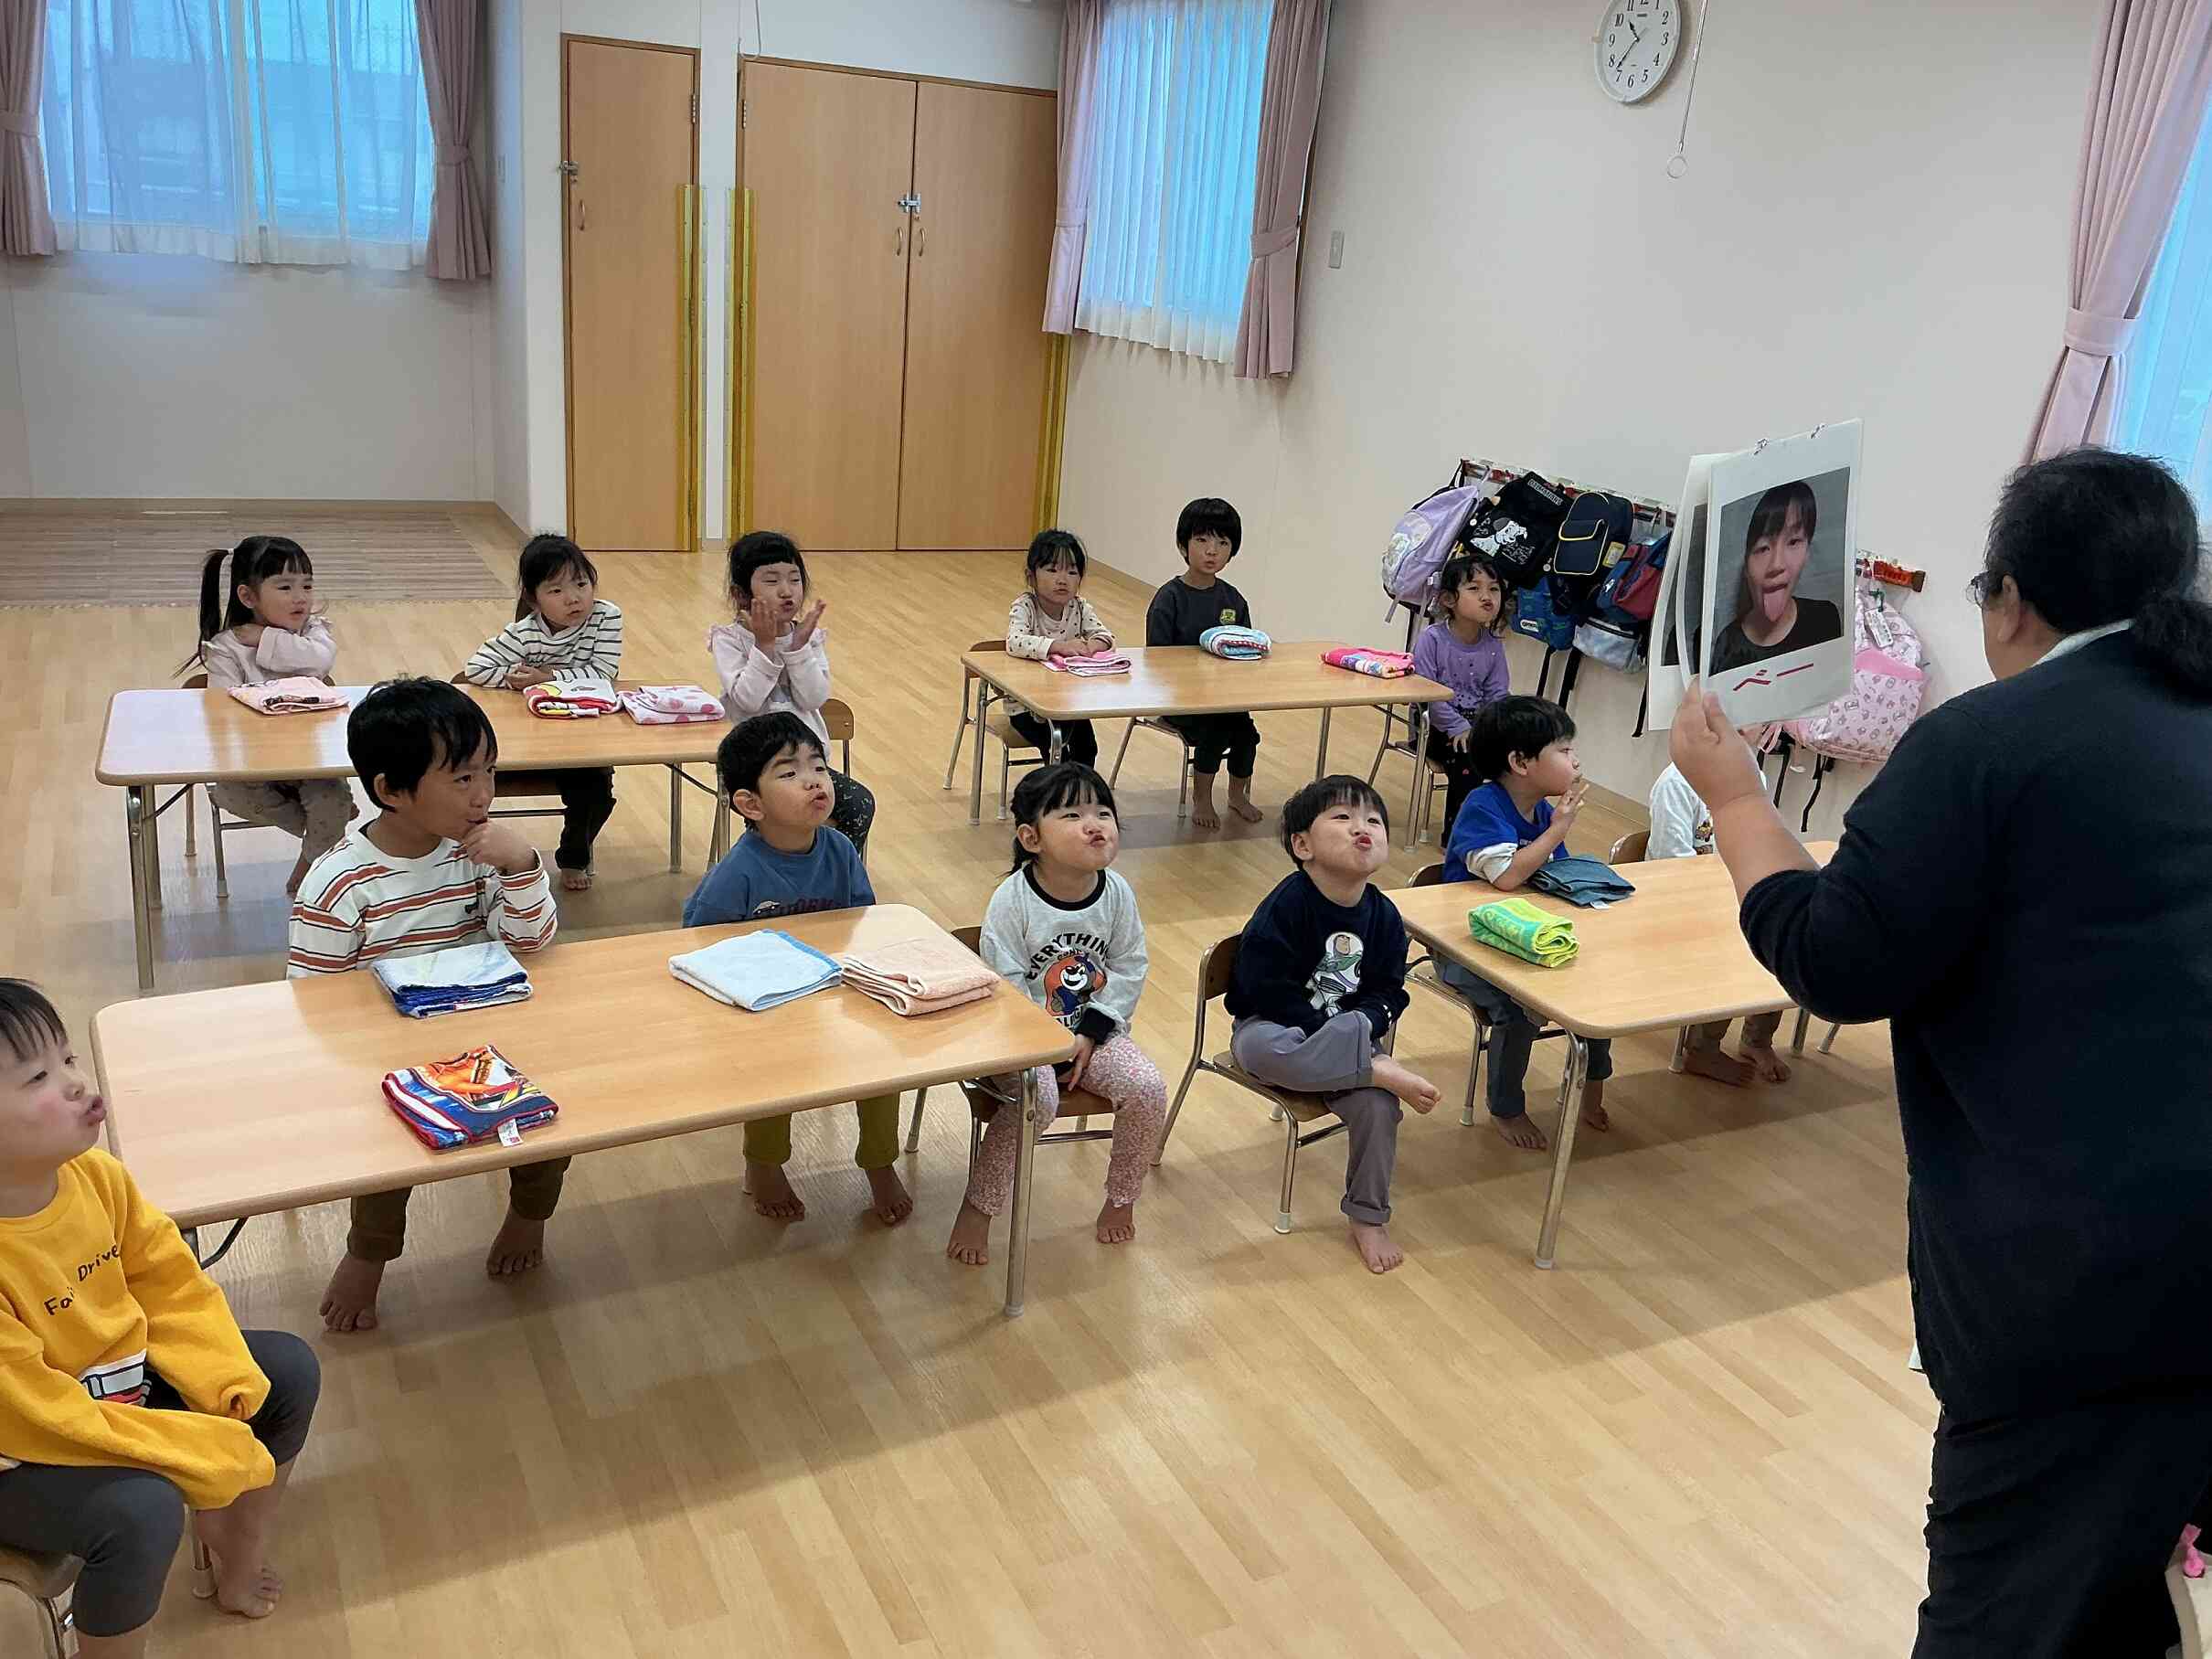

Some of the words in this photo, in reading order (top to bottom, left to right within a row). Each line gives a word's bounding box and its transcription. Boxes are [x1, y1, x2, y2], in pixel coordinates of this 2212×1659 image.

[1627, 0, 1634, 11] 11
[1615, 14, 1623, 27] 10
[1662, 10, 1669, 25] 2
[1609, 33, 1615, 47] 9
[1661, 32, 1668, 46] 3
[1609, 54, 1615, 68] 8
[1653, 52, 1660, 66] 4
[1616, 69, 1622, 82] 7
[1627, 74, 1634, 88] 6
[1641, 69, 1648, 82] 5
[43, 1286, 75, 1316] Fai
[77, 1244, 120, 1282] Drive
